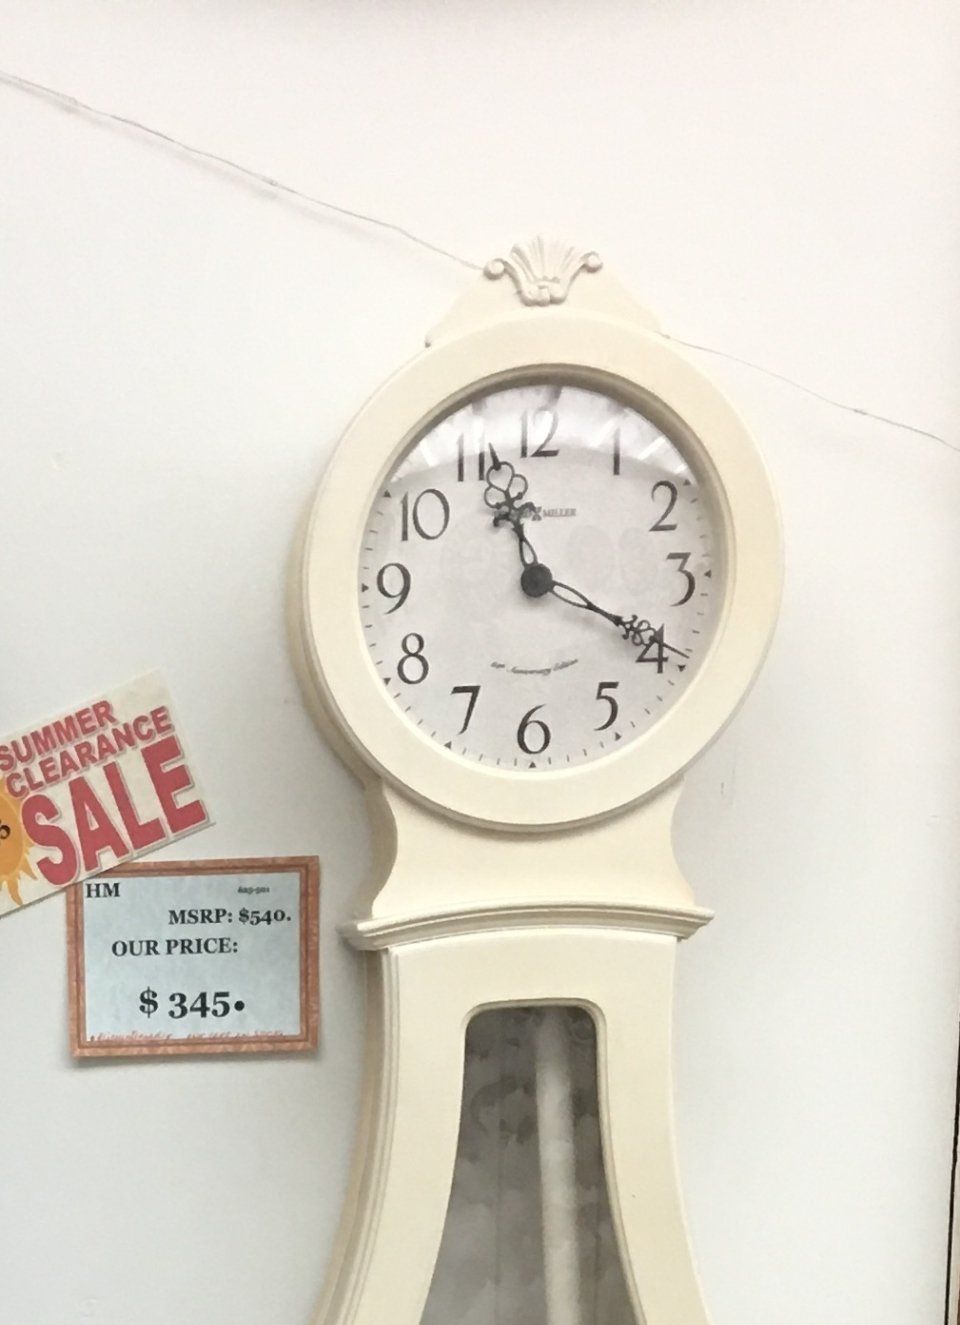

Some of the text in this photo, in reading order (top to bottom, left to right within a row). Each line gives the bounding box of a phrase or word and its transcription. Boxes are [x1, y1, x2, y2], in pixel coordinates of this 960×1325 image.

[457, 431, 486, 482] 11
[520, 408, 560, 459] 12
[612, 426, 622, 477] 1
[400, 488, 451, 541] 10
[648, 480, 679, 532] 2
[376, 562, 411, 614] 9
[665, 551, 696, 608] 3
[397, 632, 430, 685] 8
[635, 622, 669, 674] 4
[450, 685, 481, 735] 7
[517, 704, 551, 754] 6
[594, 681, 620, 731] 5
[4, 706, 175, 799] CLEARANCE
[21, 735, 208, 887] SALE
[85, 881, 120, 898] HM
[168, 907, 291, 926] MSRP: $540.
[111, 937, 239, 957] OUR PRICE:
[139, 986, 158, 1018] $
